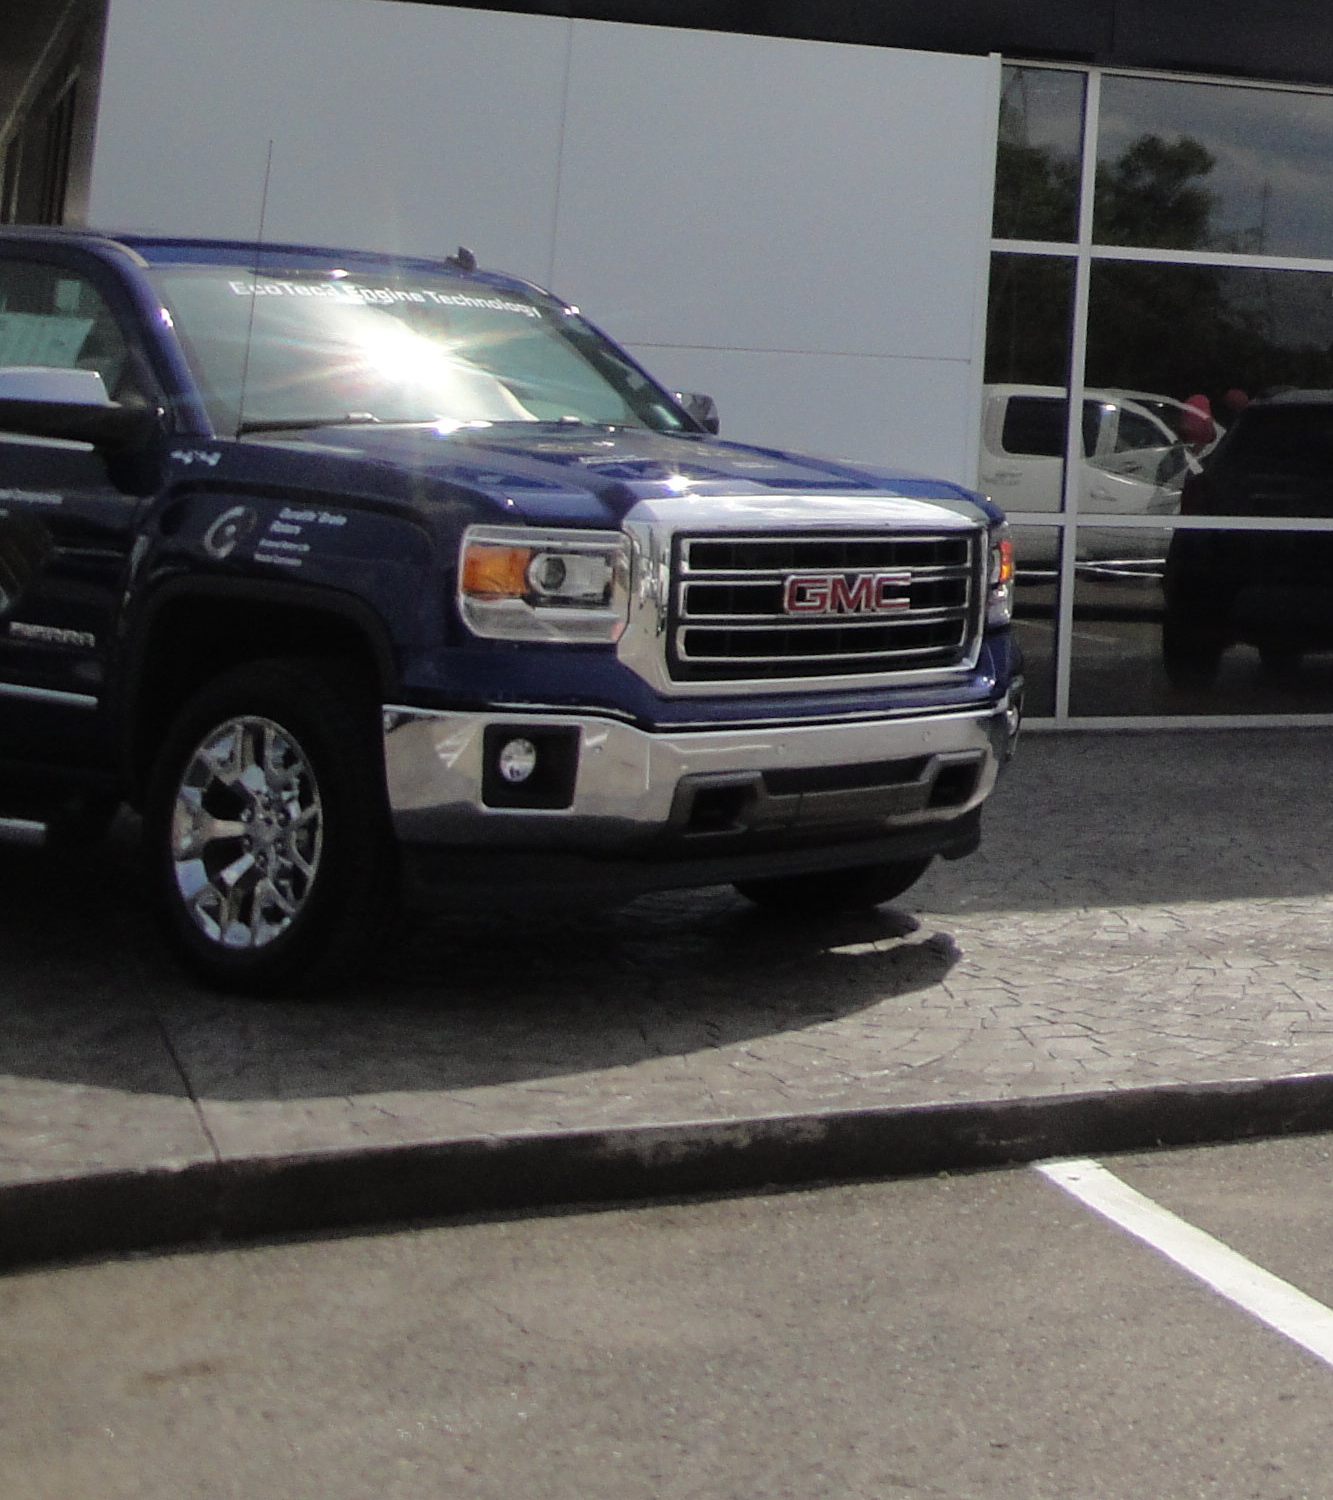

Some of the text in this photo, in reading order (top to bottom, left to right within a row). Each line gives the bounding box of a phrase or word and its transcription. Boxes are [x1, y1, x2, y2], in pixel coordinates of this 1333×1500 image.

[340, 285, 427, 305] Engine
[422, 289, 543, 319] Technology
[783, 572, 912, 616] GMC
